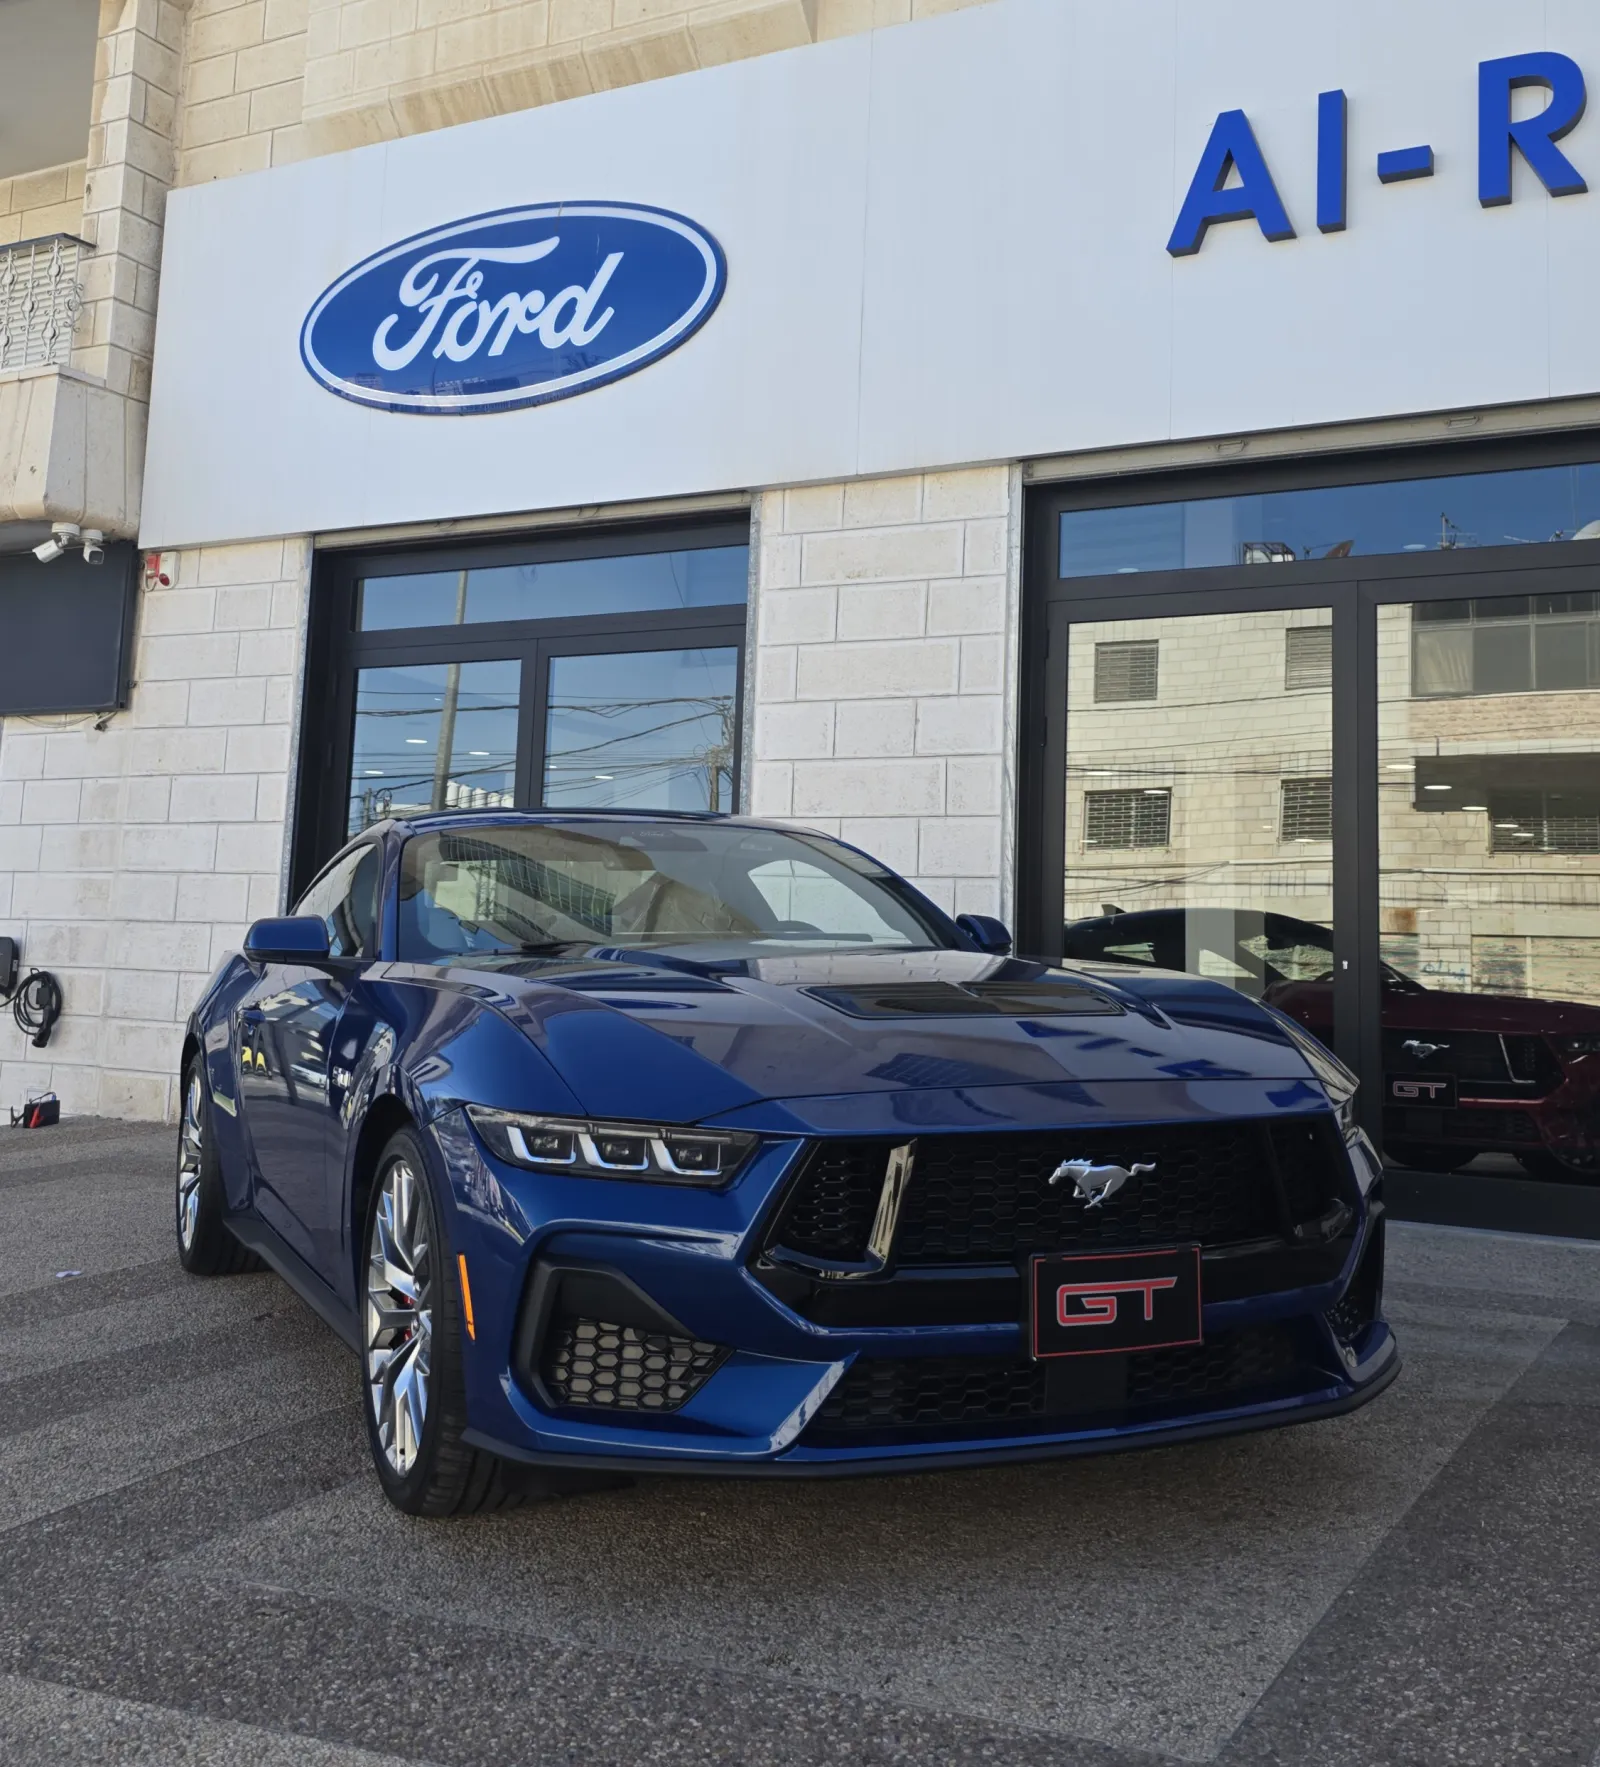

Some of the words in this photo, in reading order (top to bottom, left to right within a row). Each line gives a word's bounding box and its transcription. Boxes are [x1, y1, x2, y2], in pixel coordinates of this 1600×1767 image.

[372, 236, 624, 371] Ford
[1392, 1080, 1448, 1099] GT
[1056, 1276, 1178, 1327] GT
